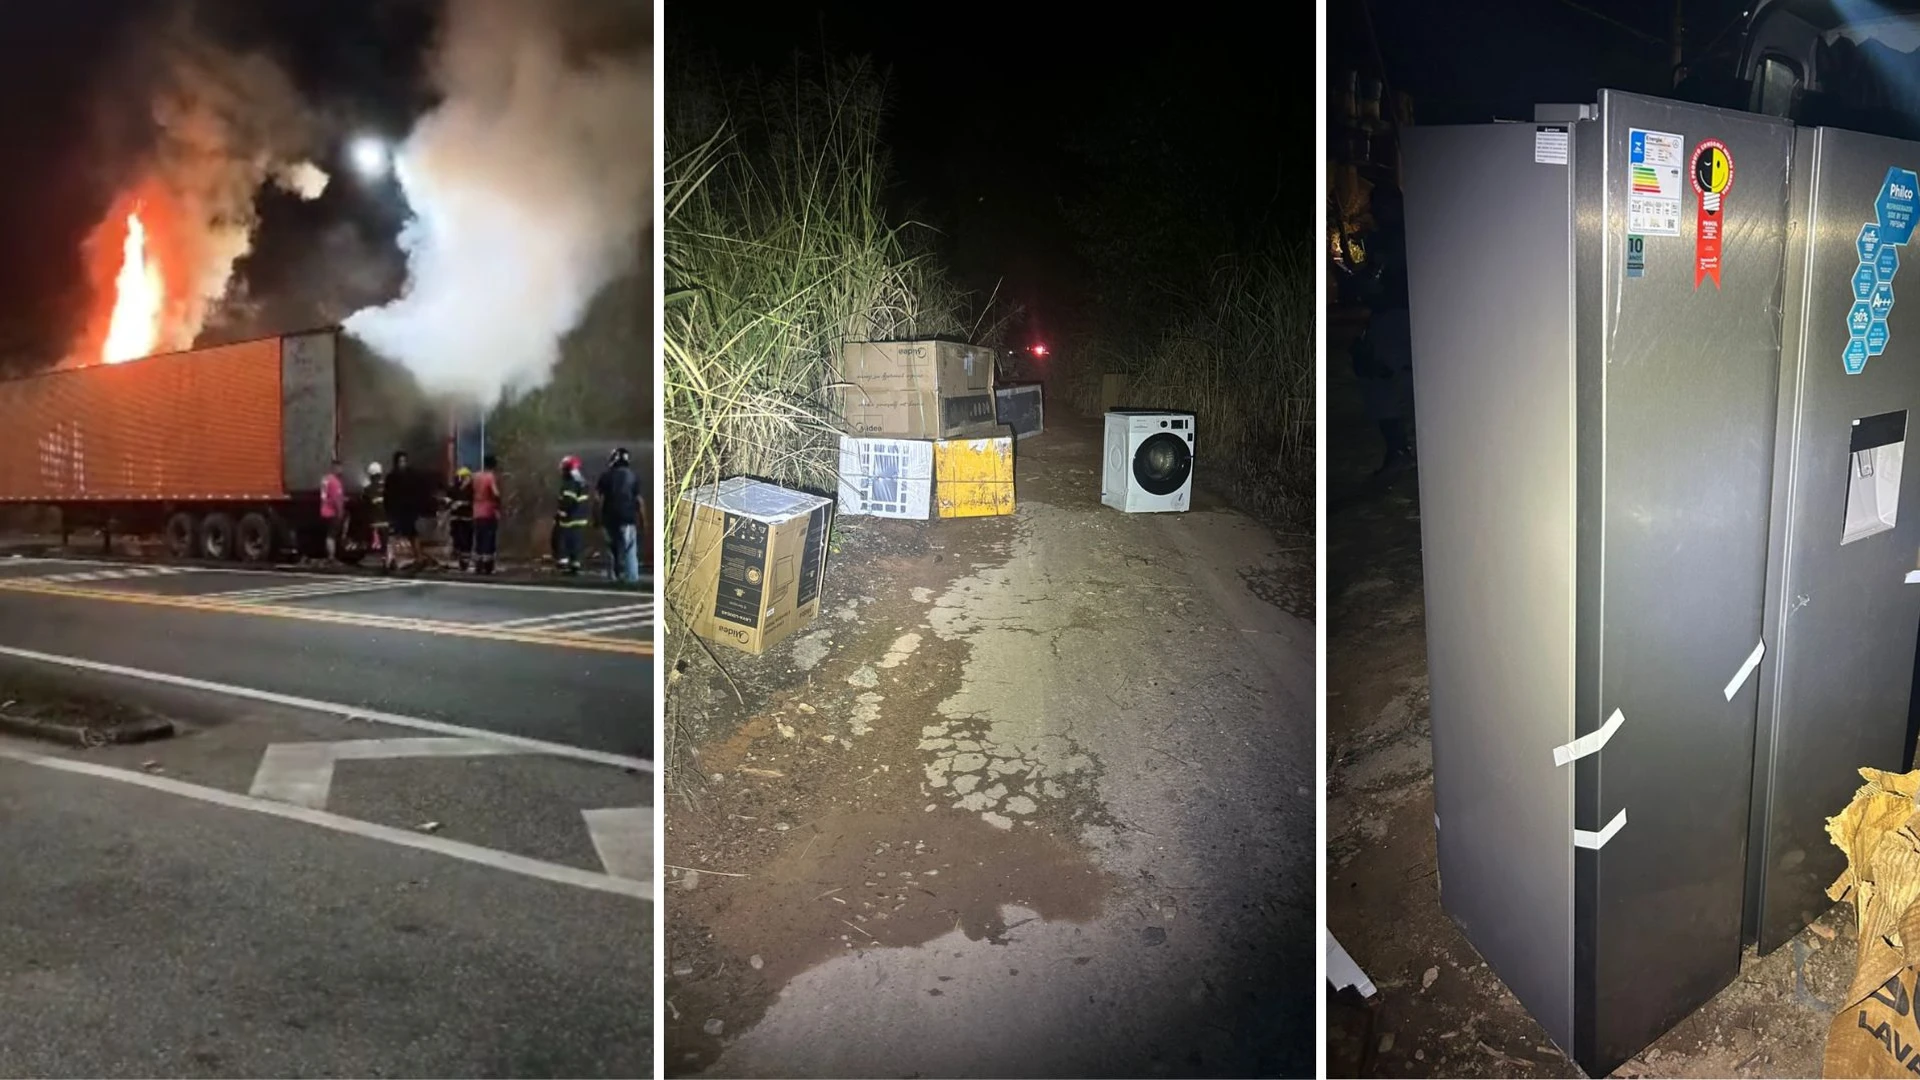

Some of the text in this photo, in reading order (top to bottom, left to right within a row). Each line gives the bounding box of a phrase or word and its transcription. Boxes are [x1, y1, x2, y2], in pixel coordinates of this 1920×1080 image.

[1700, 141, 1724, 150] CONSOME
[1890, 183, 1914, 200] Philco
[1629, 238, 1643, 253] 10
[1853, 312, 1868, 322] 30%
[898, 347, 927, 359] Midea
[718, 625, 750, 645] Midea
